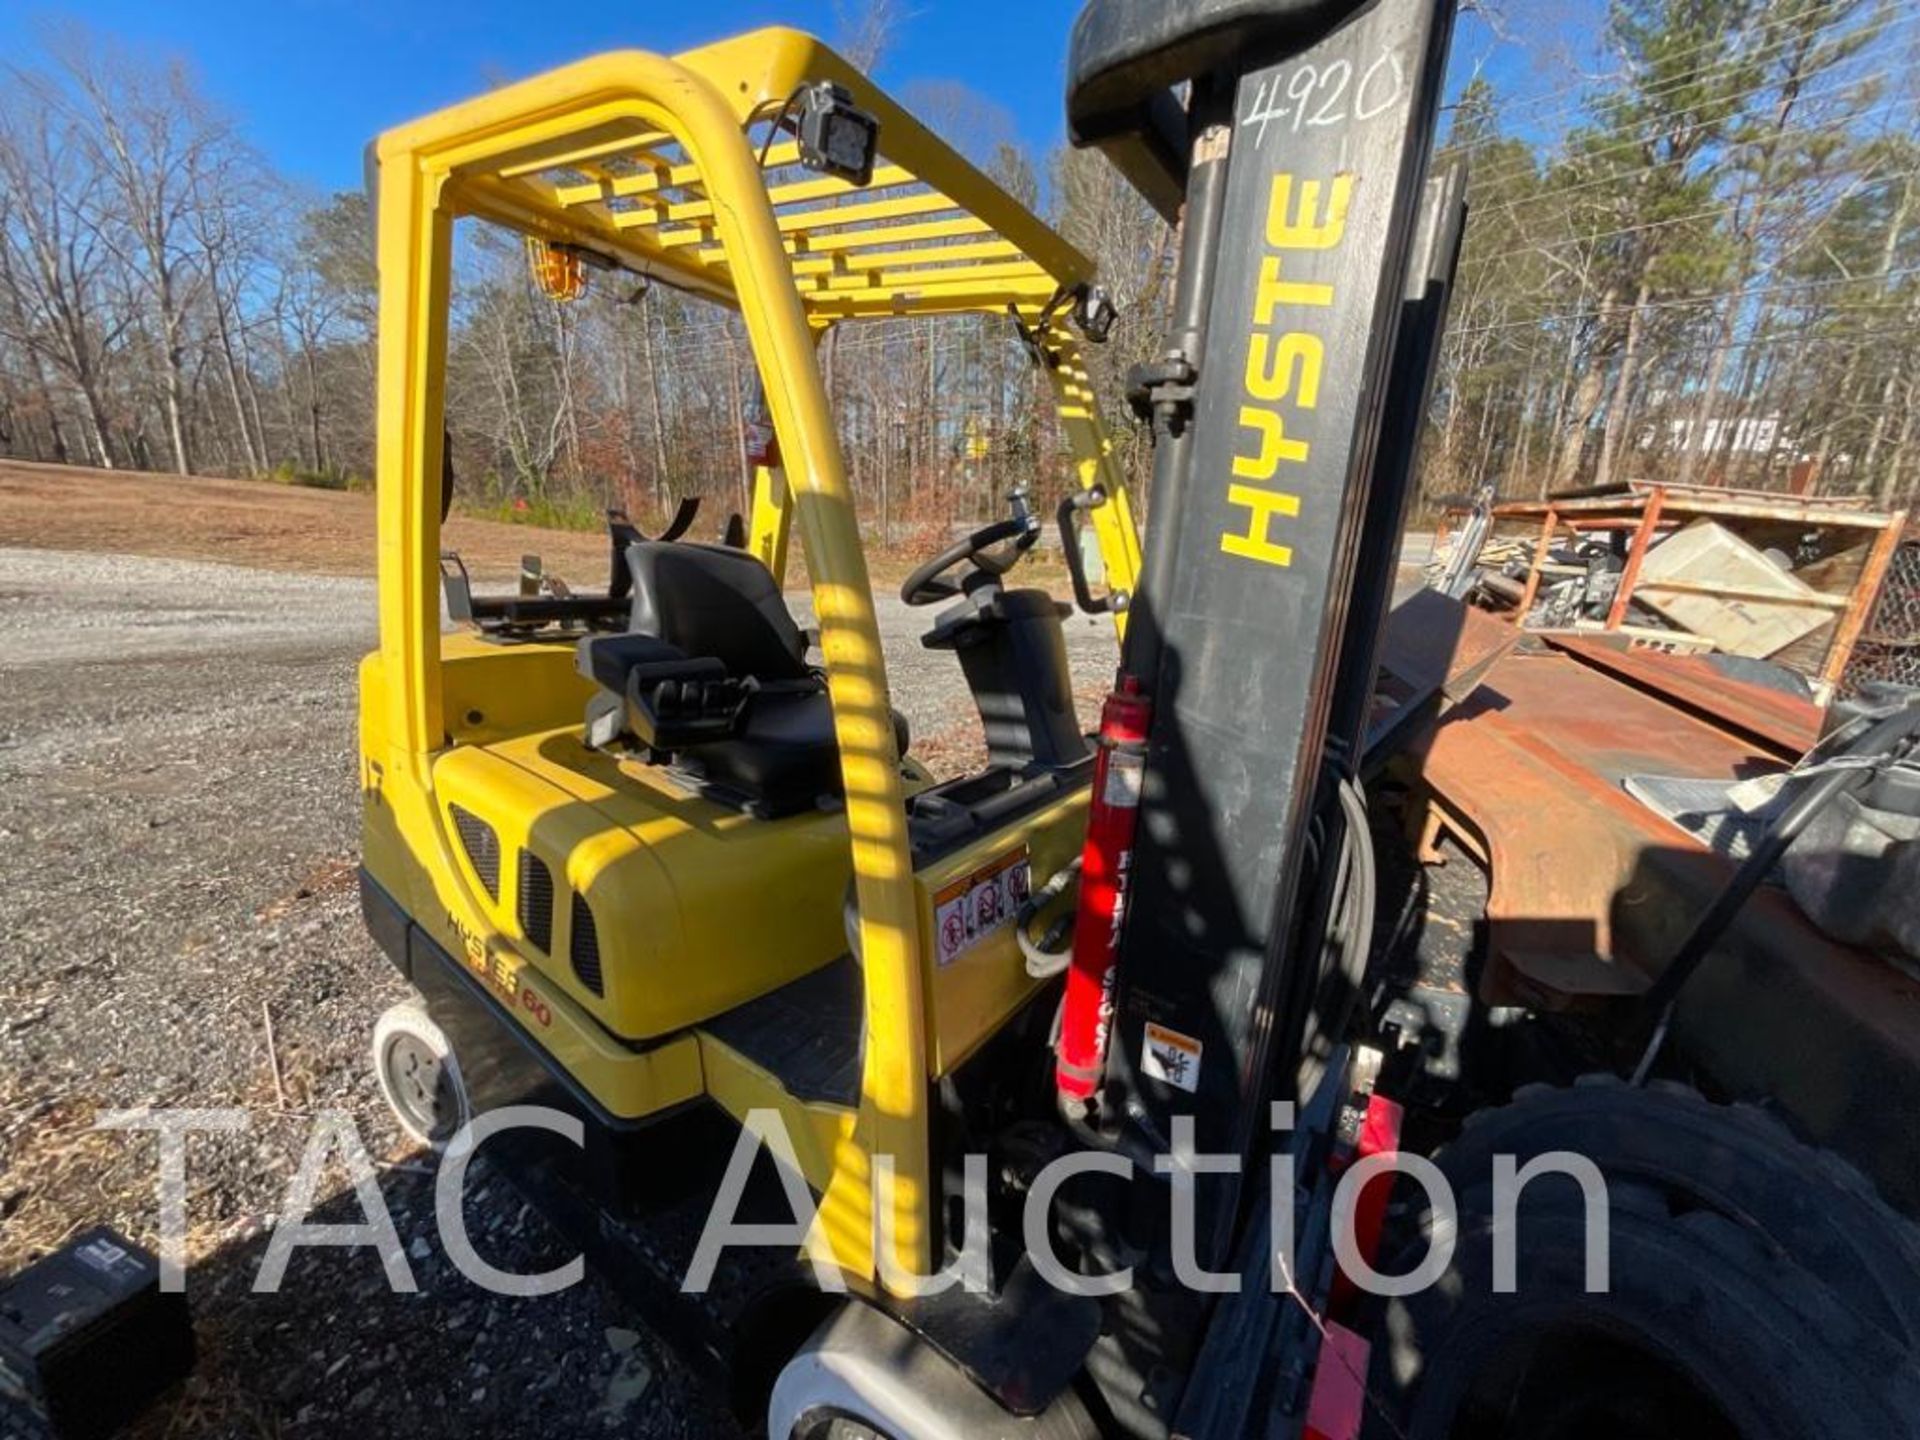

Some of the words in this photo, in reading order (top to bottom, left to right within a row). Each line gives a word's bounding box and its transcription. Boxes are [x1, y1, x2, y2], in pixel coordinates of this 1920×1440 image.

[1241, 46, 1404, 149] 4920
[447, 909, 519, 996] HYSTER
[522, 987, 553, 1027] 60
